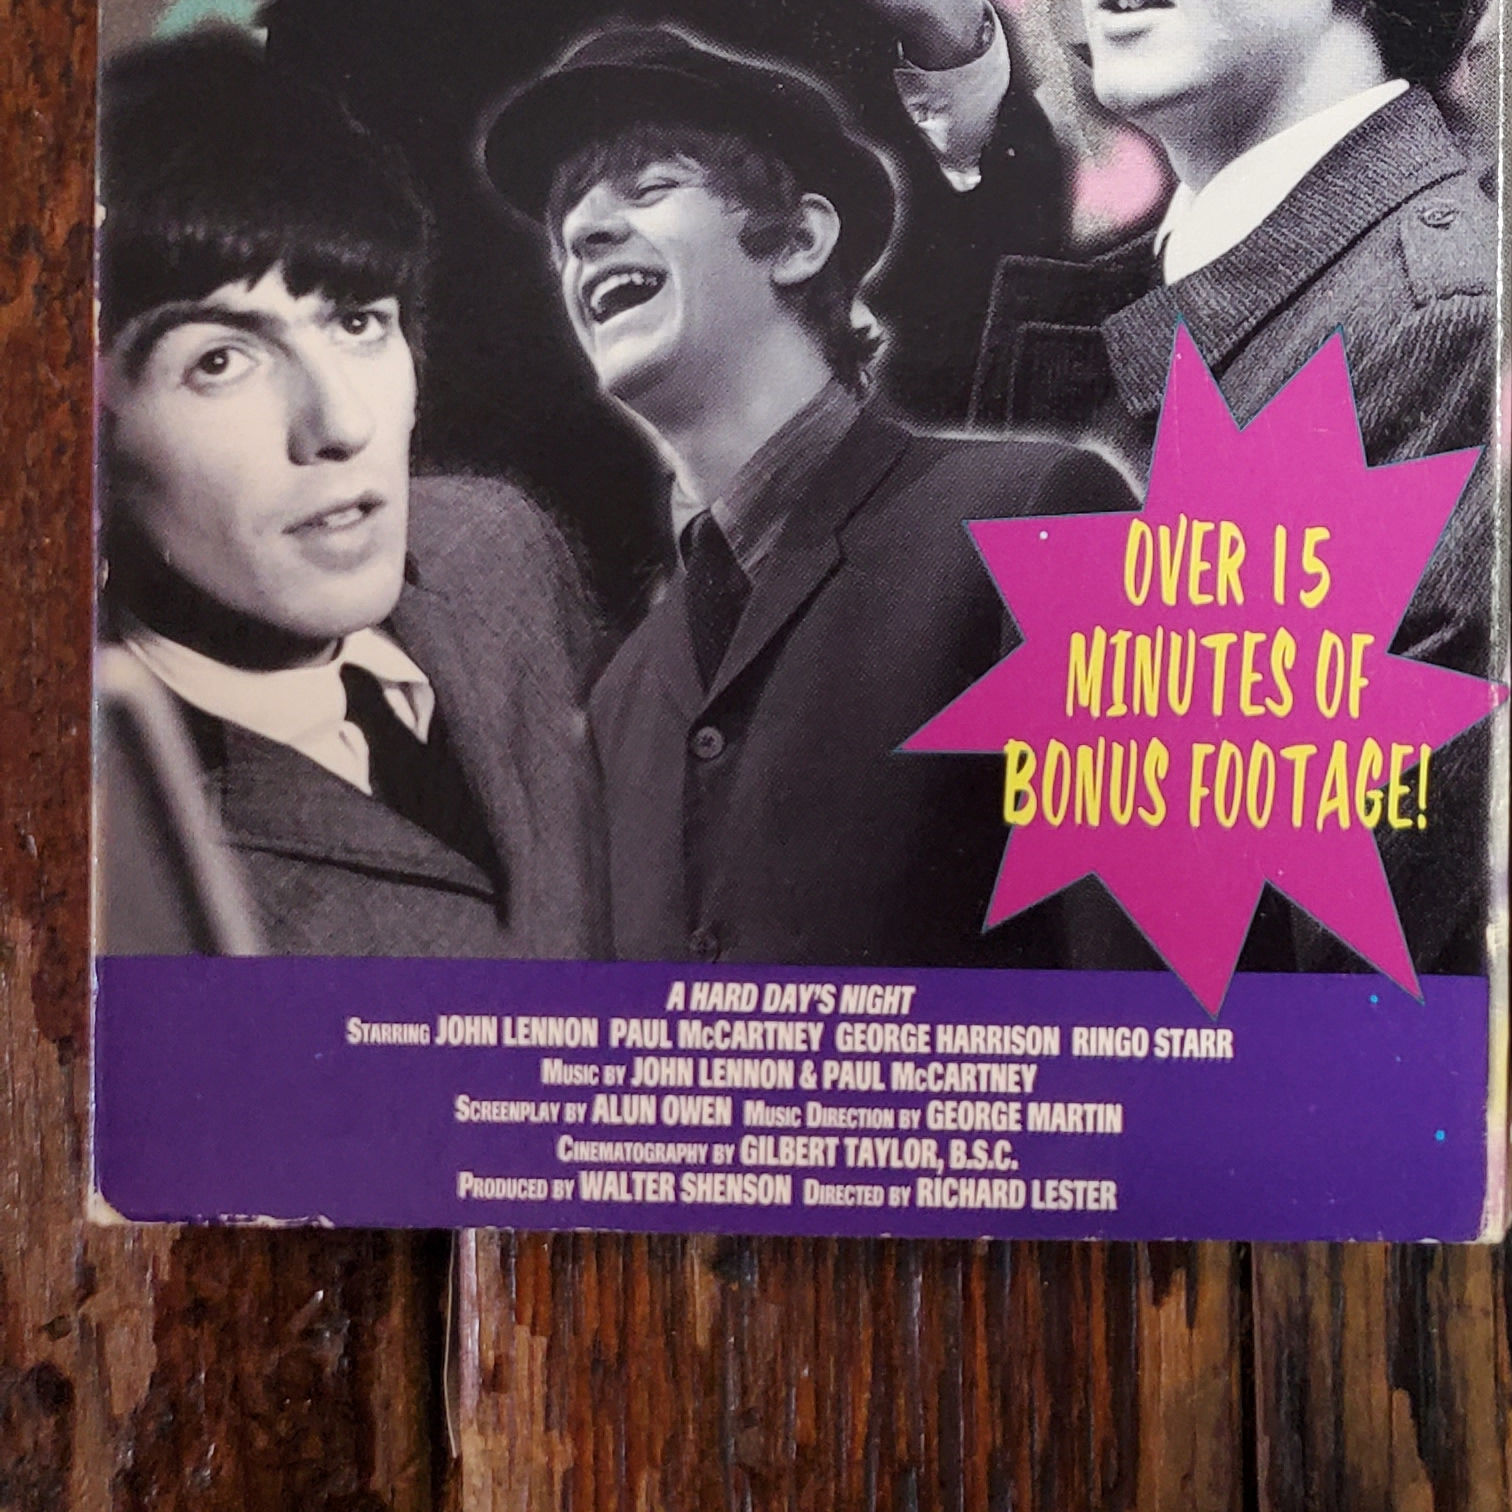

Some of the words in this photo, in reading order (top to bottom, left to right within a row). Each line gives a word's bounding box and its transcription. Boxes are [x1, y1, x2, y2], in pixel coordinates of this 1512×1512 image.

[1124, 514, 1246, 606] OVER
[1273, 524, 1331, 608] 15
[1066, 626, 1296, 718] MINUTES
[1315, 629, 1375, 718] OF
[1002, 737, 1169, 828] BONUS
[1188, 737, 1432, 832] FOOTAGE!
[667, 981, 685, 1011] A
[690, 981, 758, 1013] HARD
[762, 983, 836, 1014] DAY'S
[840, 984, 915, 1016] NIGHT
[435, 1015, 497, 1046] JOHN
[502, 1016, 598, 1048] LENNON
[610, 1018, 672, 1049] PAUL
[836, 1022, 931, 1054] GEORGE
[936, 1025, 1060, 1056] HARRISON
[1072, 1026, 1148, 1058] RINGO
[1154, 1028, 1233, 1059] STARR
[632, 1056, 693, 1088] JOHN
[699, 1057, 794, 1089] LENNON
[799, 1061, 818, 1089] &
[823, 1061, 884, 1091] PAUL
[592, 1095, 656, 1125] ALUN
[662, 1095, 732, 1127] OWEN
[926, 1100, 1022, 1131] GEORGE
[1027, 1102, 1122, 1134] MARTIN
[740, 1135, 841, 1167] GILBERT
[844, 1138, 944, 1175] TAYLOR,
[949, 1139, 1019, 1171] B.S.C.
[579, 1170, 675, 1203] WALTER
[680, 1171, 792, 1205] SHENSON
[916, 1177, 1026, 1209] RICHARD
[1030, 1179, 1117, 1211] LESTER
